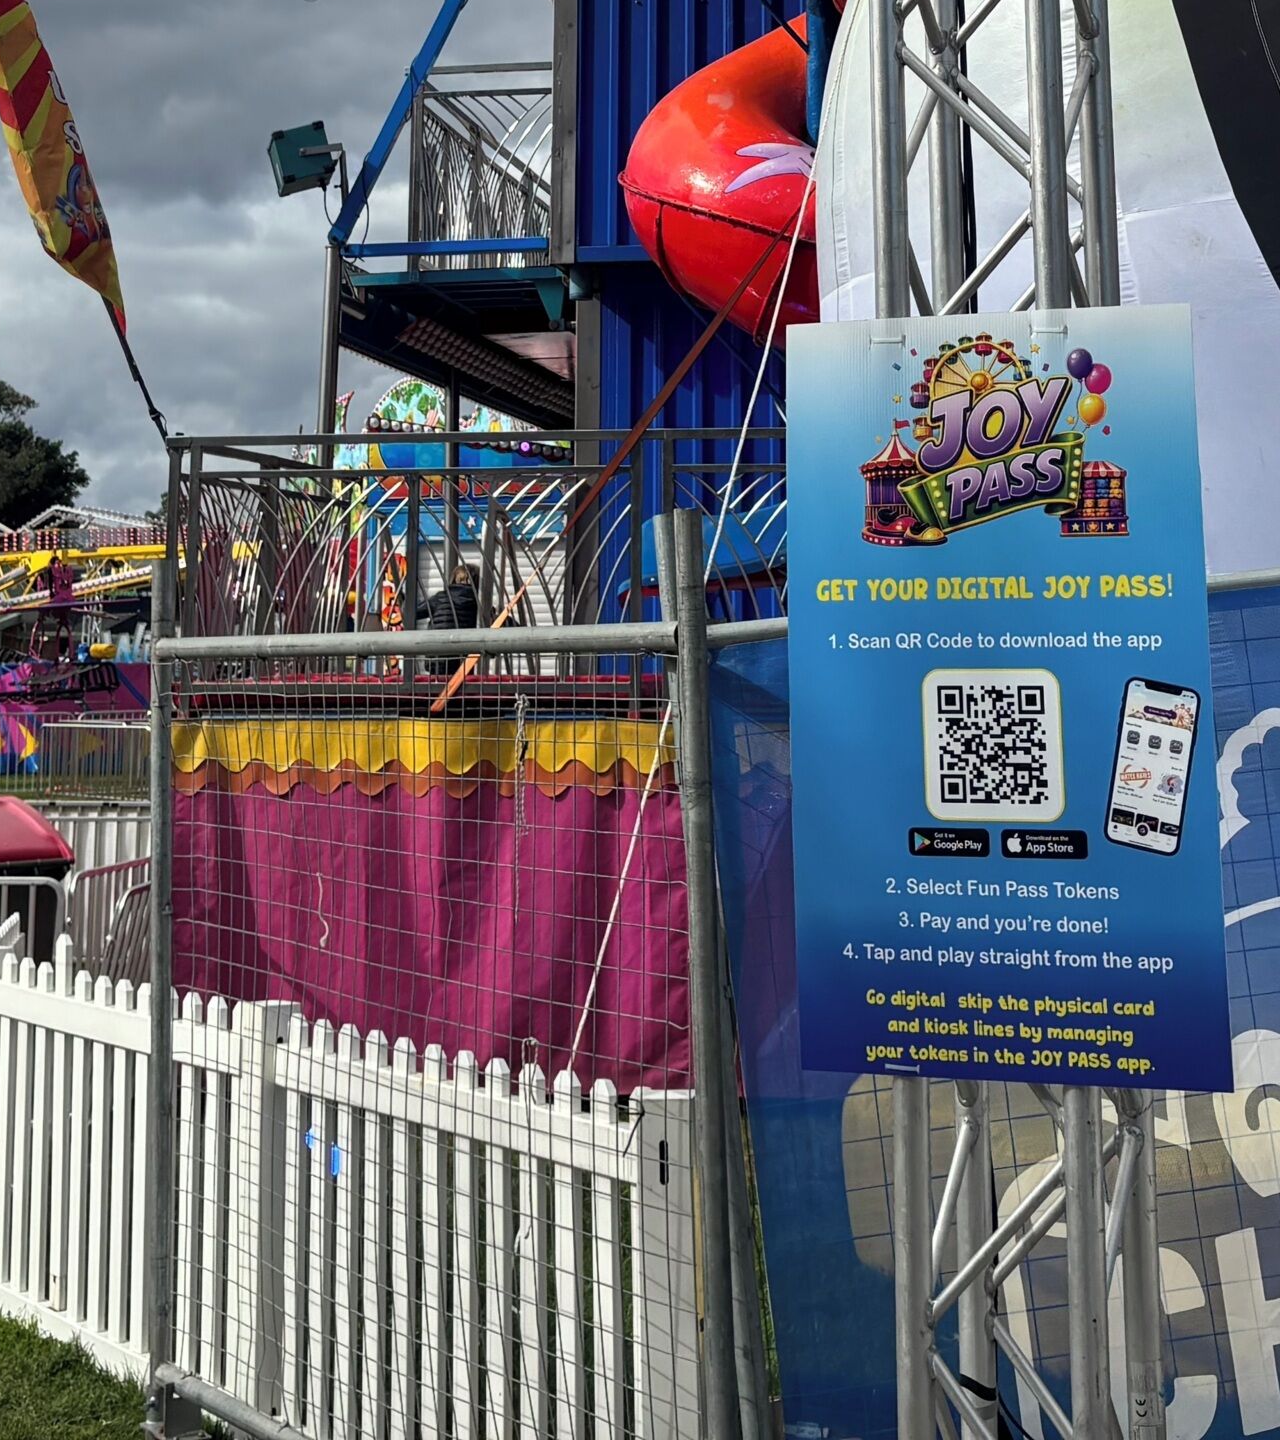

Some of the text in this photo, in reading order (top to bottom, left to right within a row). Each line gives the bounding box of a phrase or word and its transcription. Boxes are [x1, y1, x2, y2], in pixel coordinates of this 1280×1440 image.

[922, 378, 1071, 469] JOY
[947, 447, 1065, 521] PASS
[816, 572, 1173, 601] GET YOUR DIGITAL JOY PASS!
[829, 631, 1163, 651] 1. Scan QR Code to download the app
[933, 839, 982, 852] Google Play
[1026, 834, 1052, 842] Download
[1026, 842, 1074, 855] App Store
[886, 877, 1120, 900] 2. Select Fun Pass Tokens
[899, 911, 914, 927] 3.
[920, 912, 951, 933] Pay
[956, 914, 989, 930] and
[1057, 916, 1108, 933] done!
[843, 943, 1173, 974] 4. Tap and play straight from the app
[866, 989, 1155, 1017] Go digital skip the physical card
[888, 1018, 1133, 1047] and kiosk lines by managing
[866, 1044, 1156, 1075] your tokens in the JOY PASS app.
